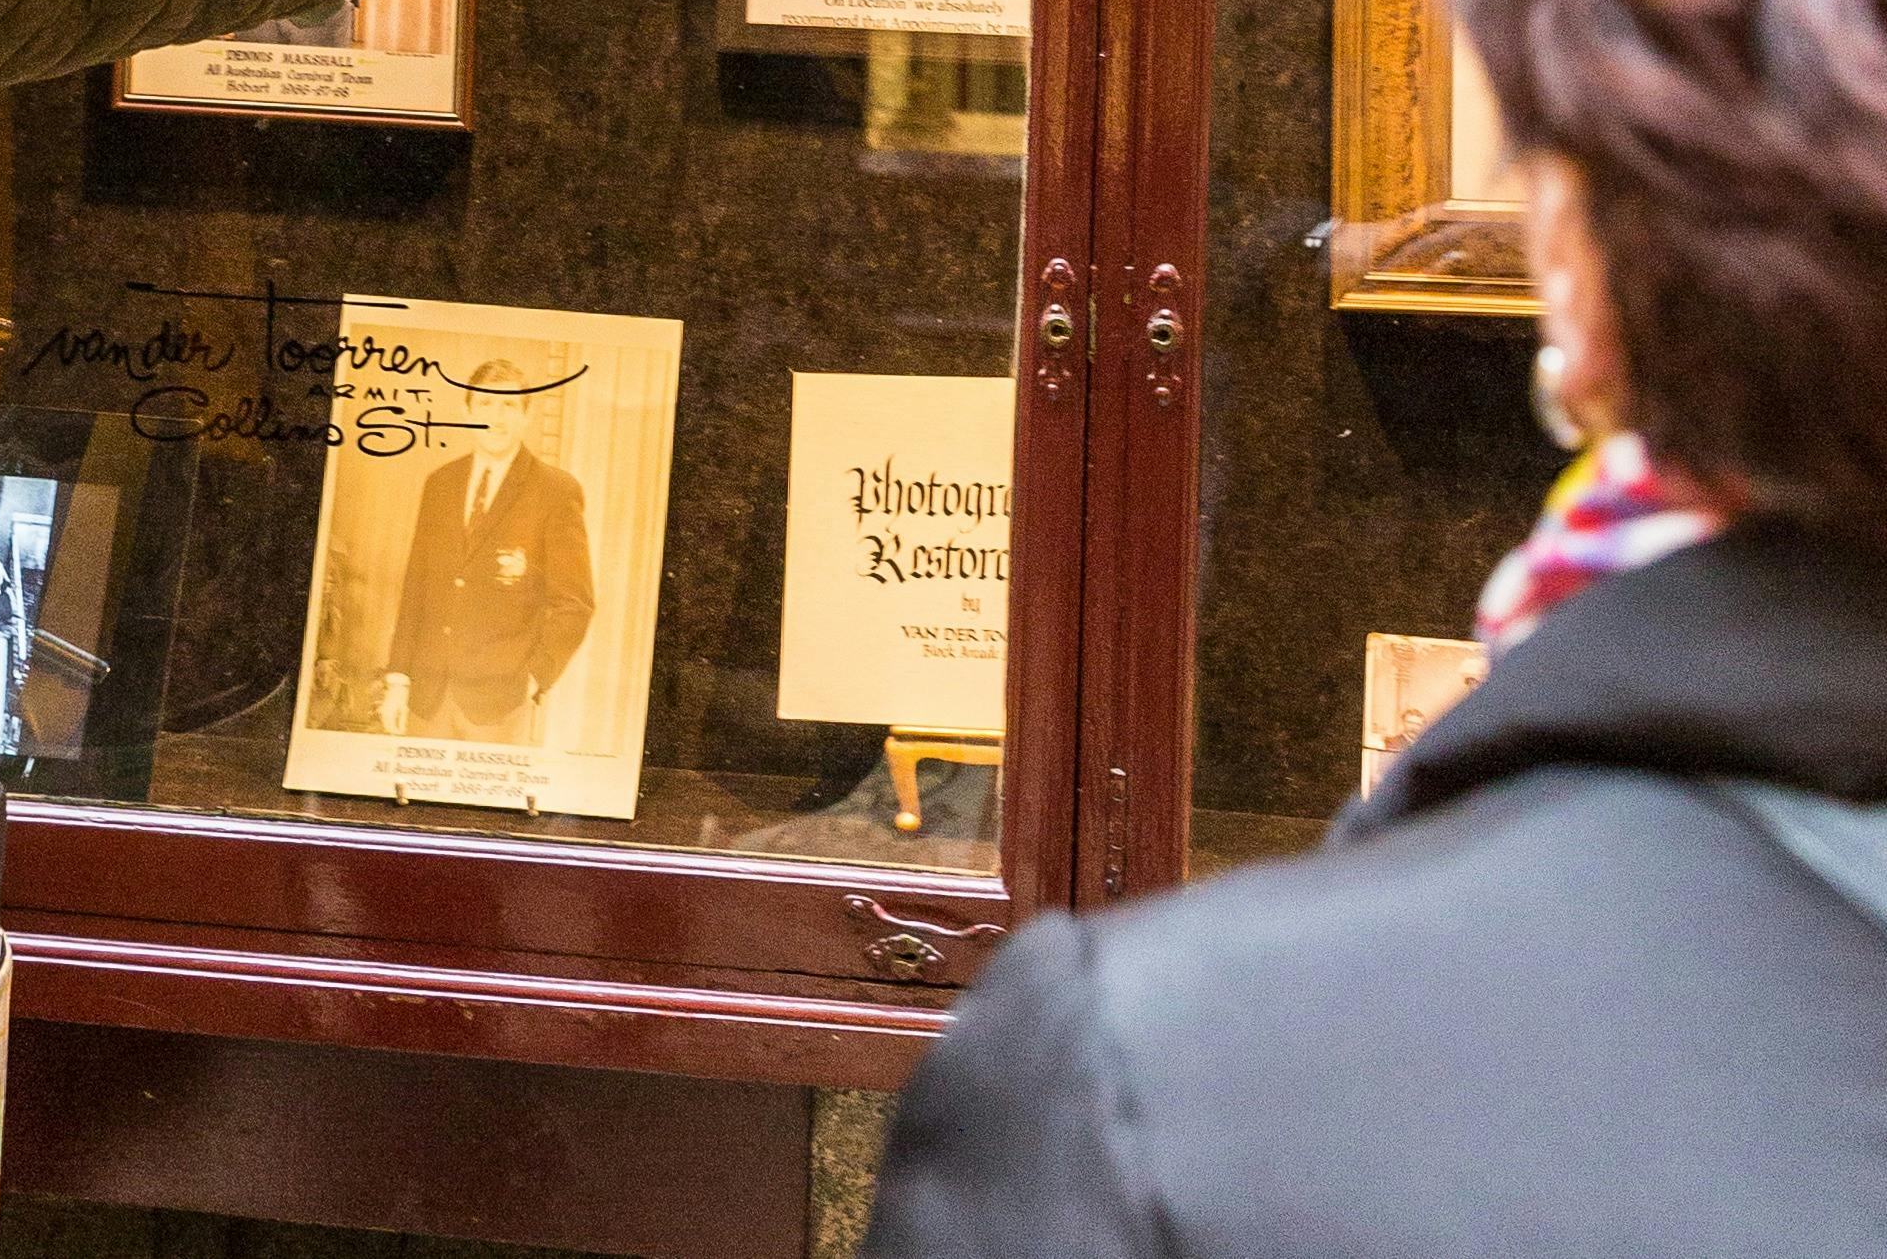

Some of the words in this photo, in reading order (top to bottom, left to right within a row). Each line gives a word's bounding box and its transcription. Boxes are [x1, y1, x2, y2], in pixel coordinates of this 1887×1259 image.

[914, 1, 933, 11] we
[937, 0, 1004, 17] absolutely
[781, 14, 858, 27] recommend
[225, 49, 273, 63] DENNIS
[282, 52, 354, 68] MARSHALL
[205, 63, 222, 76] All
[224, 64, 282, 79] Australian
[286, 69, 335, 82] Carnival
[340, 71, 374, 85] Team
[20, 326, 156, 382] van
[142, 320, 237, 372] der
[130, 385, 344, 447] Collins
[355, 405, 492, 457] St.
[900, 625, 939, 640] VAN
[943, 627, 980, 642] DER
[396, 745, 447, 760] DENNIS
[455, 749, 532, 767] MARSHALL
[372, 760, 391, 773] All
[394, 762, 453, 778] Australian
[458, 767, 510, 783] Carnival
[515, 770, 551, 785] Team
[406, 781, 440, 792] obart
